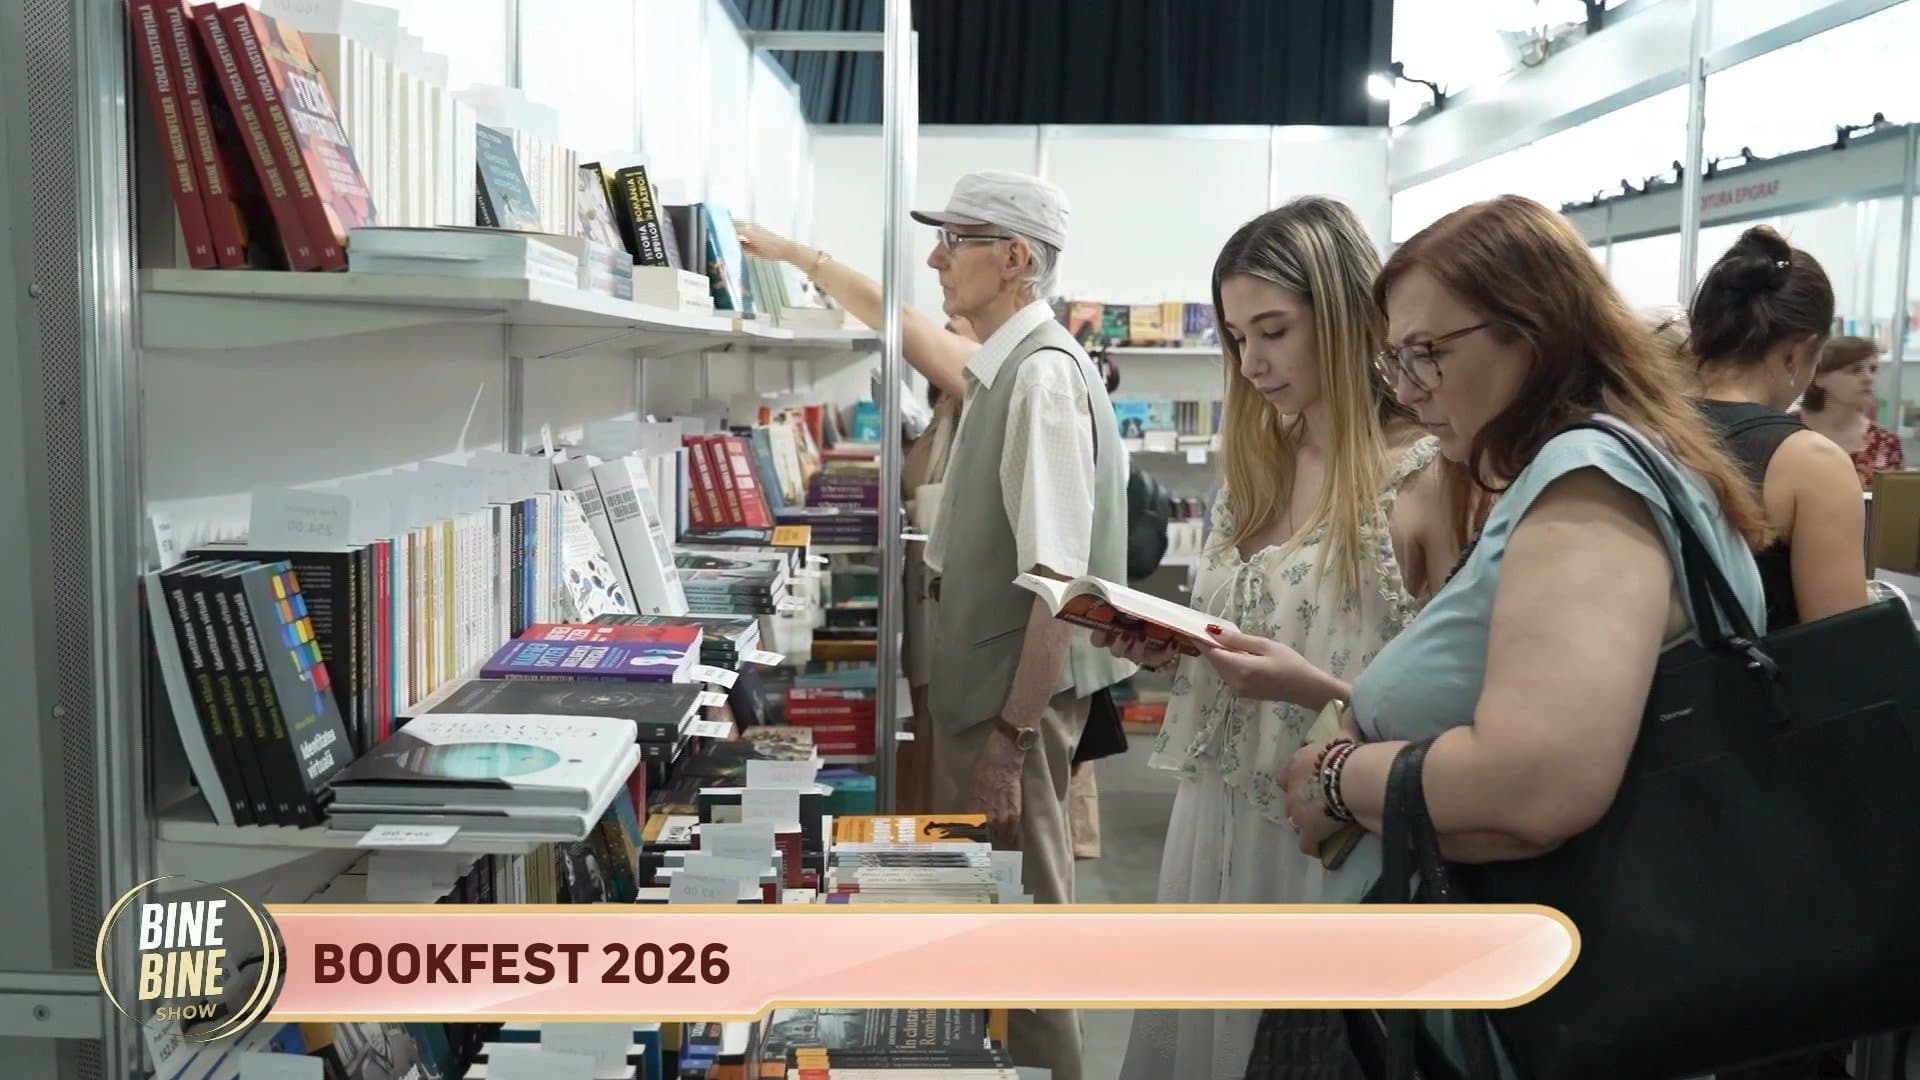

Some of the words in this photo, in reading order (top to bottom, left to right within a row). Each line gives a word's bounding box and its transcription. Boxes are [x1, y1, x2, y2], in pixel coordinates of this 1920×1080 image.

[638, 224, 654, 260] ISTORIA
[300, 728, 337, 760] Identitatea
[307, 749, 335, 779] virtuală
